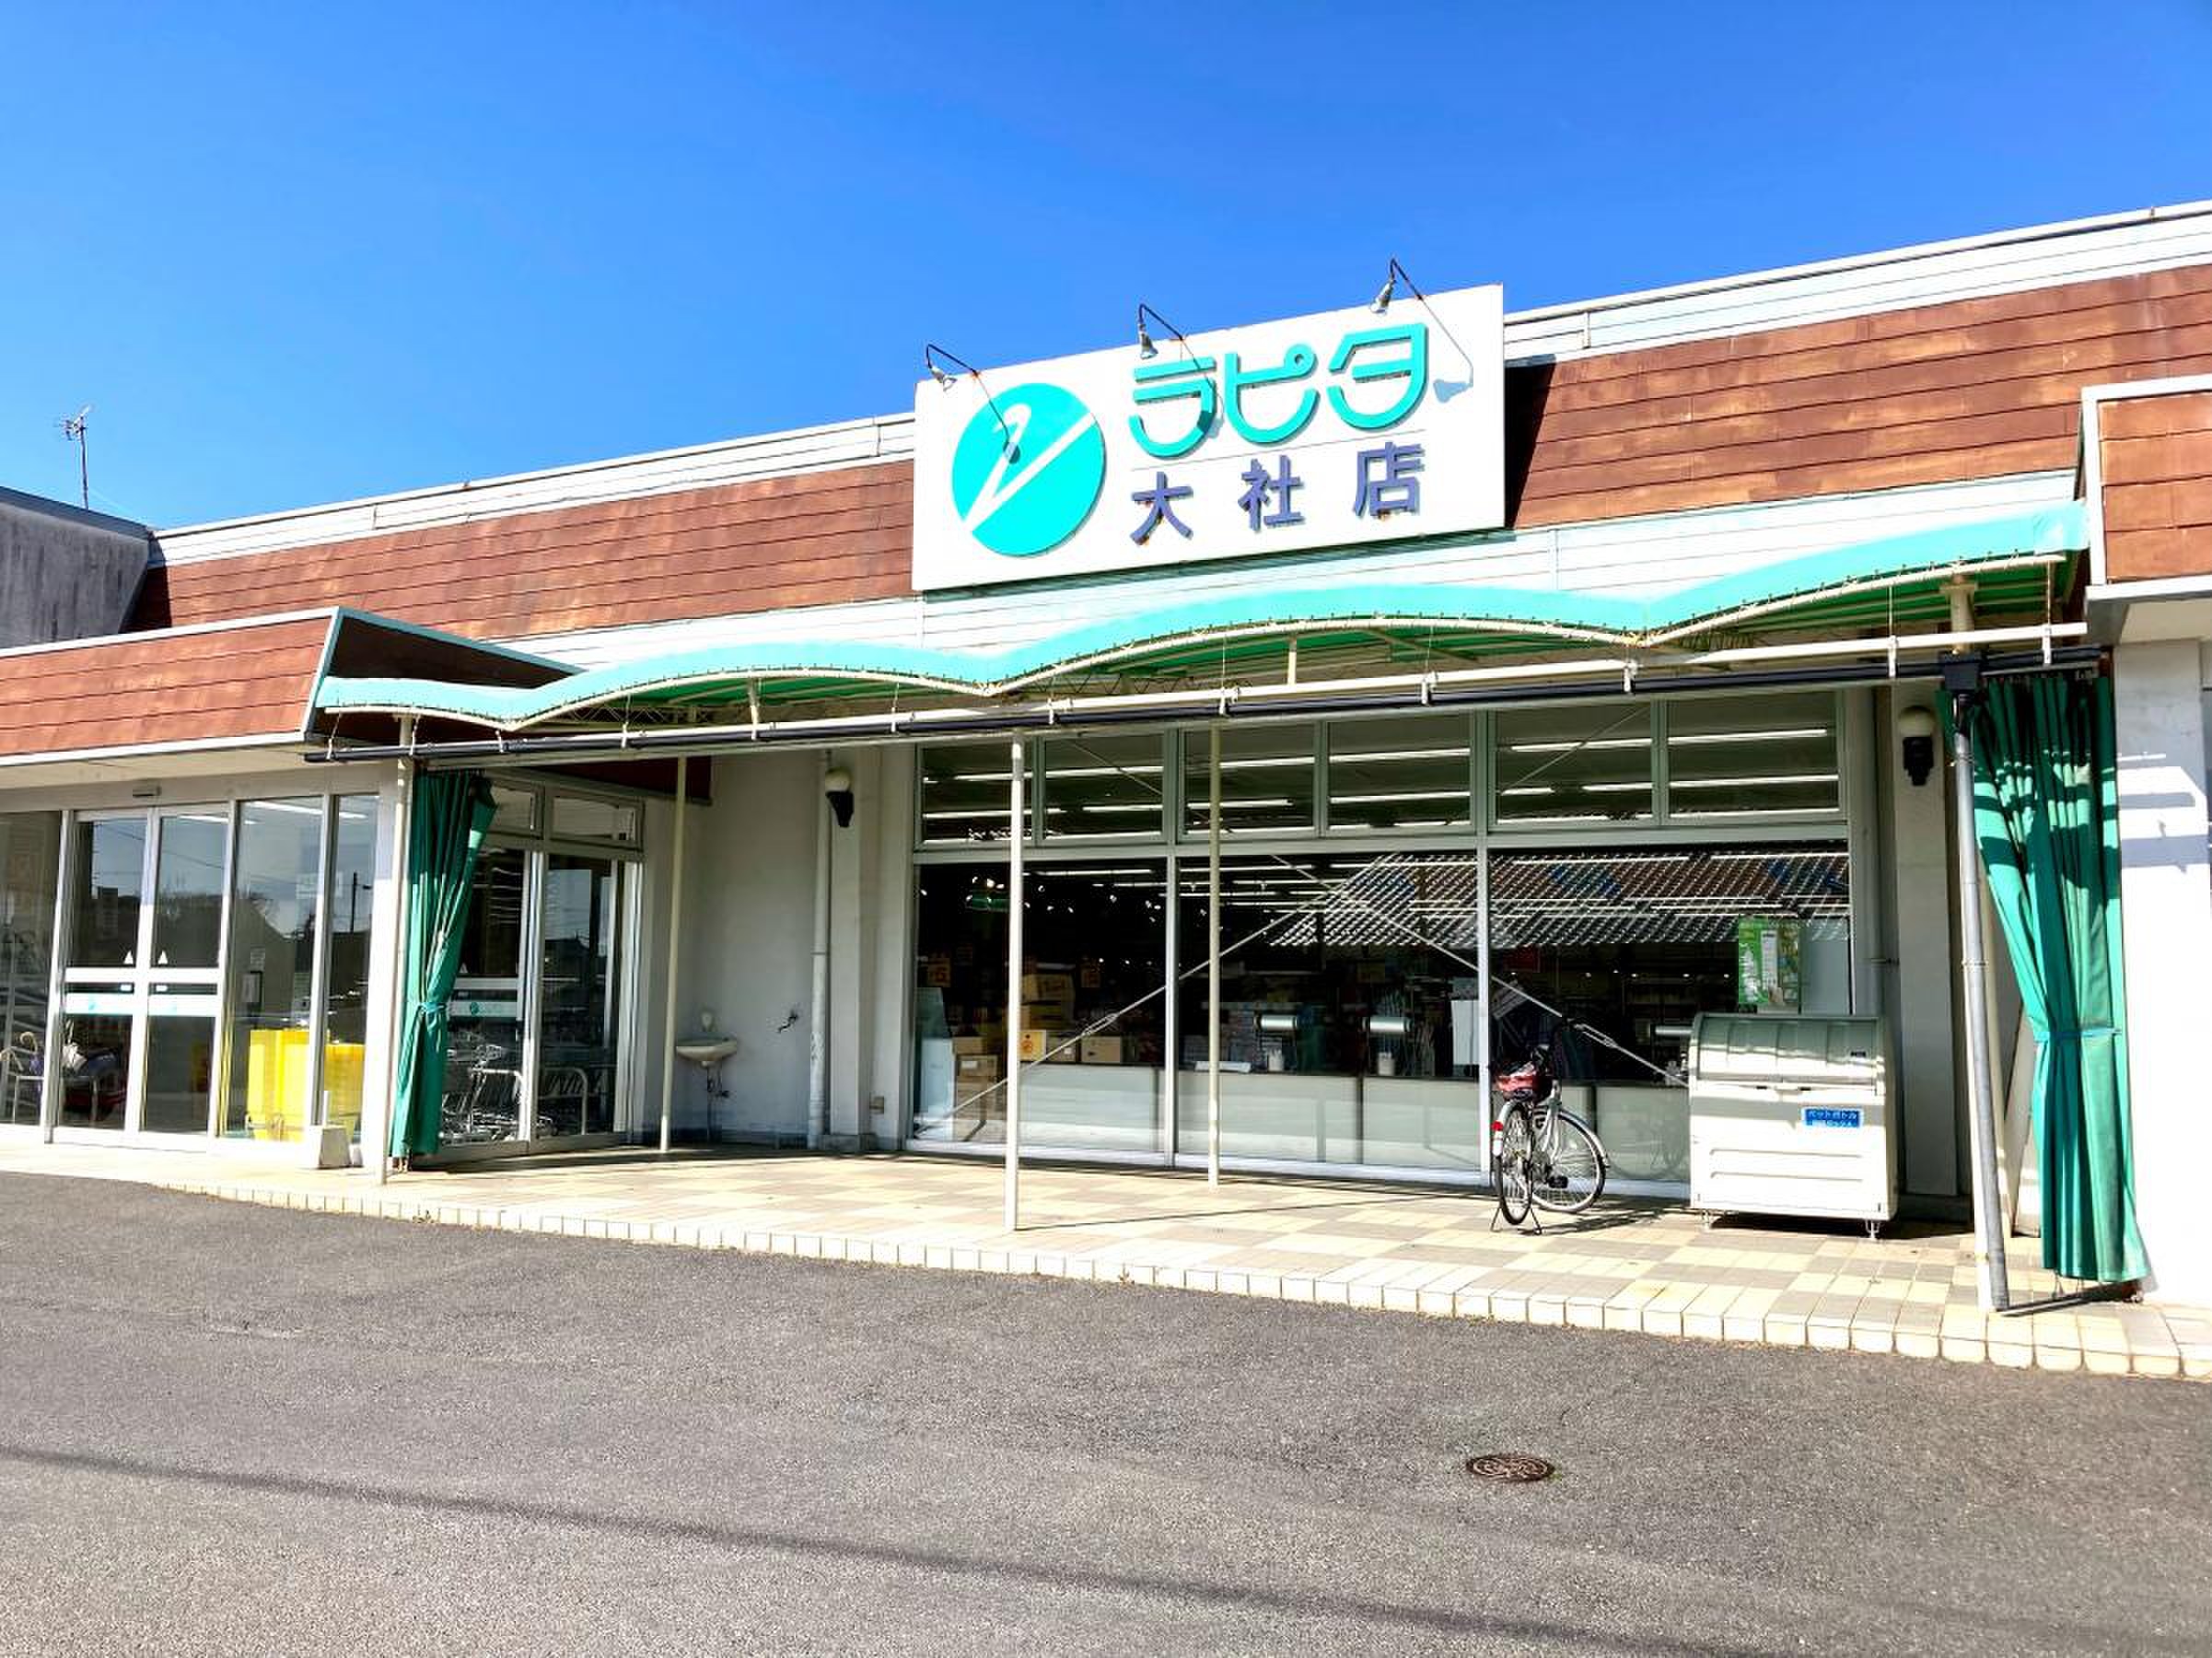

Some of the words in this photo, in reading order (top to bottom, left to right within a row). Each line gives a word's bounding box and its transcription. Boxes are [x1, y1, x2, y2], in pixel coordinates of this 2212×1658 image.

[1129, 322, 1428, 458] ラピタ
[1131, 441, 1426, 545] 大社店
